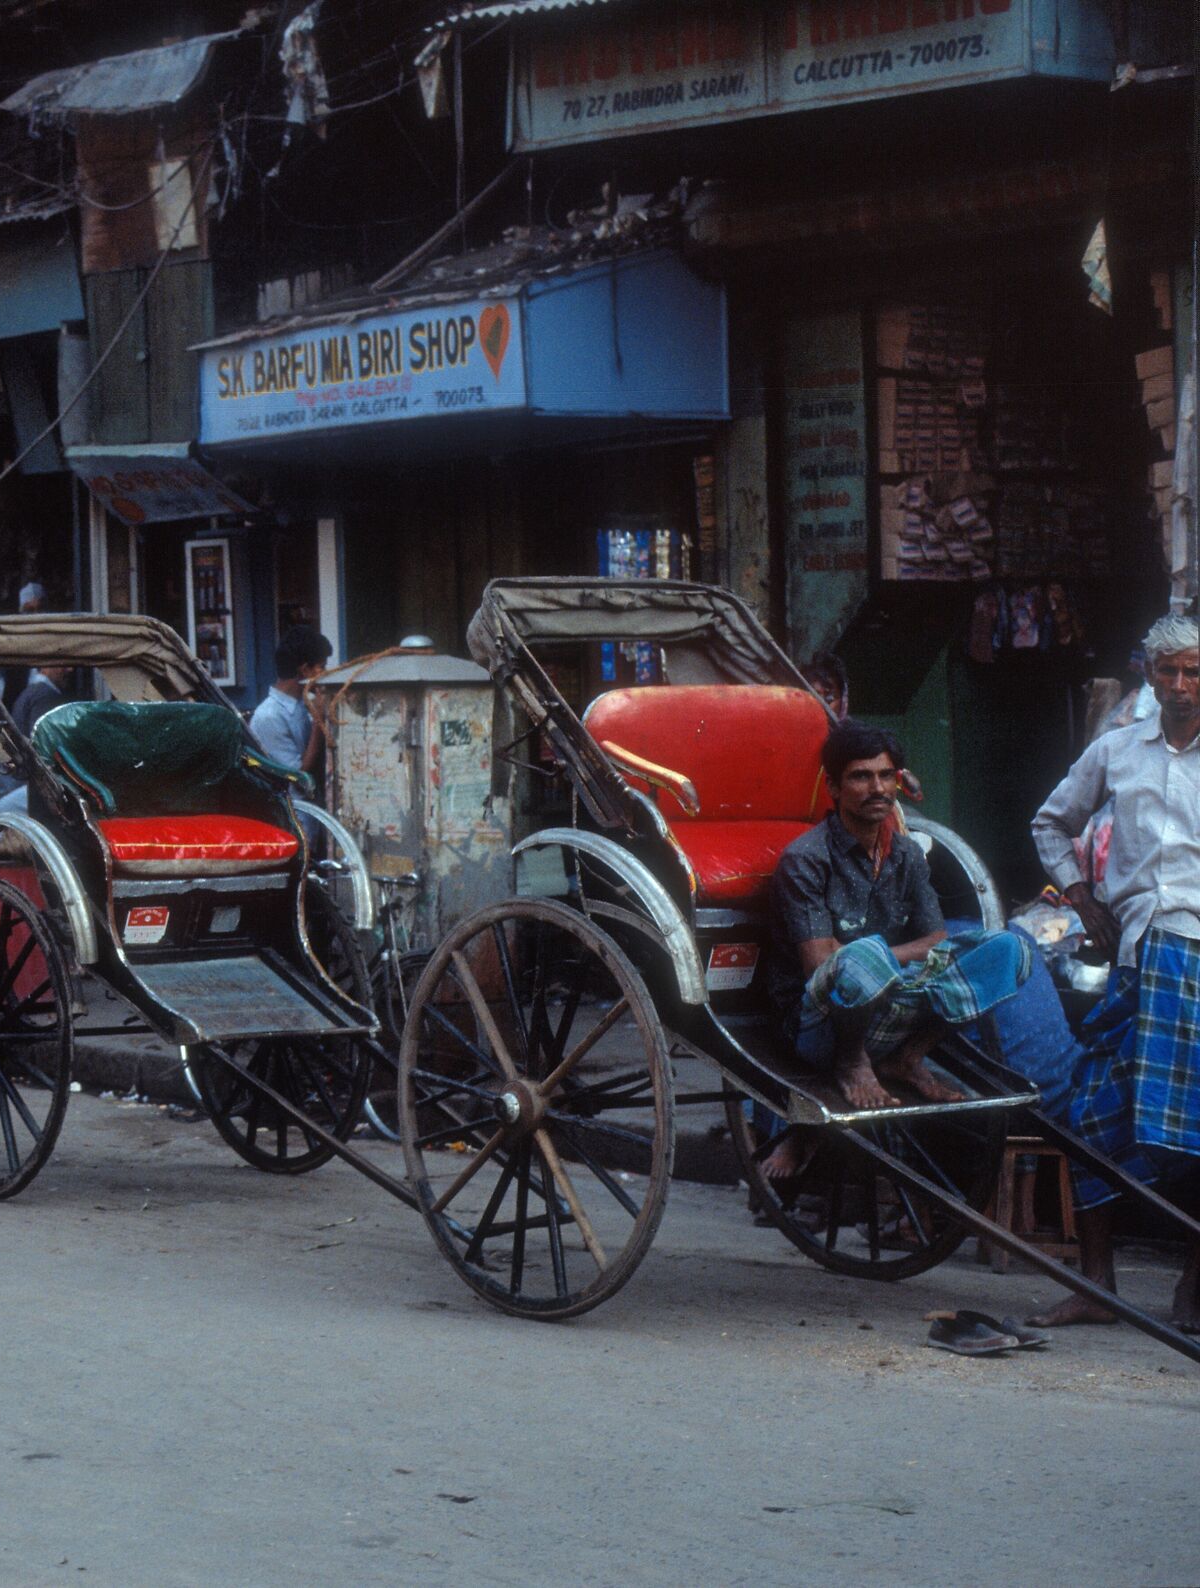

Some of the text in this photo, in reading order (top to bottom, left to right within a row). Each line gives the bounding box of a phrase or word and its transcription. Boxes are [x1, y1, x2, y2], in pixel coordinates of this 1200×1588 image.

[612, 82, 684, 115] RABINDRA
[254, 337, 317, 394] BARFU
[321, 332, 353, 384] MIA
[357, 324, 403, 380] BIRI
[409, 314, 477, 373] SHOP
